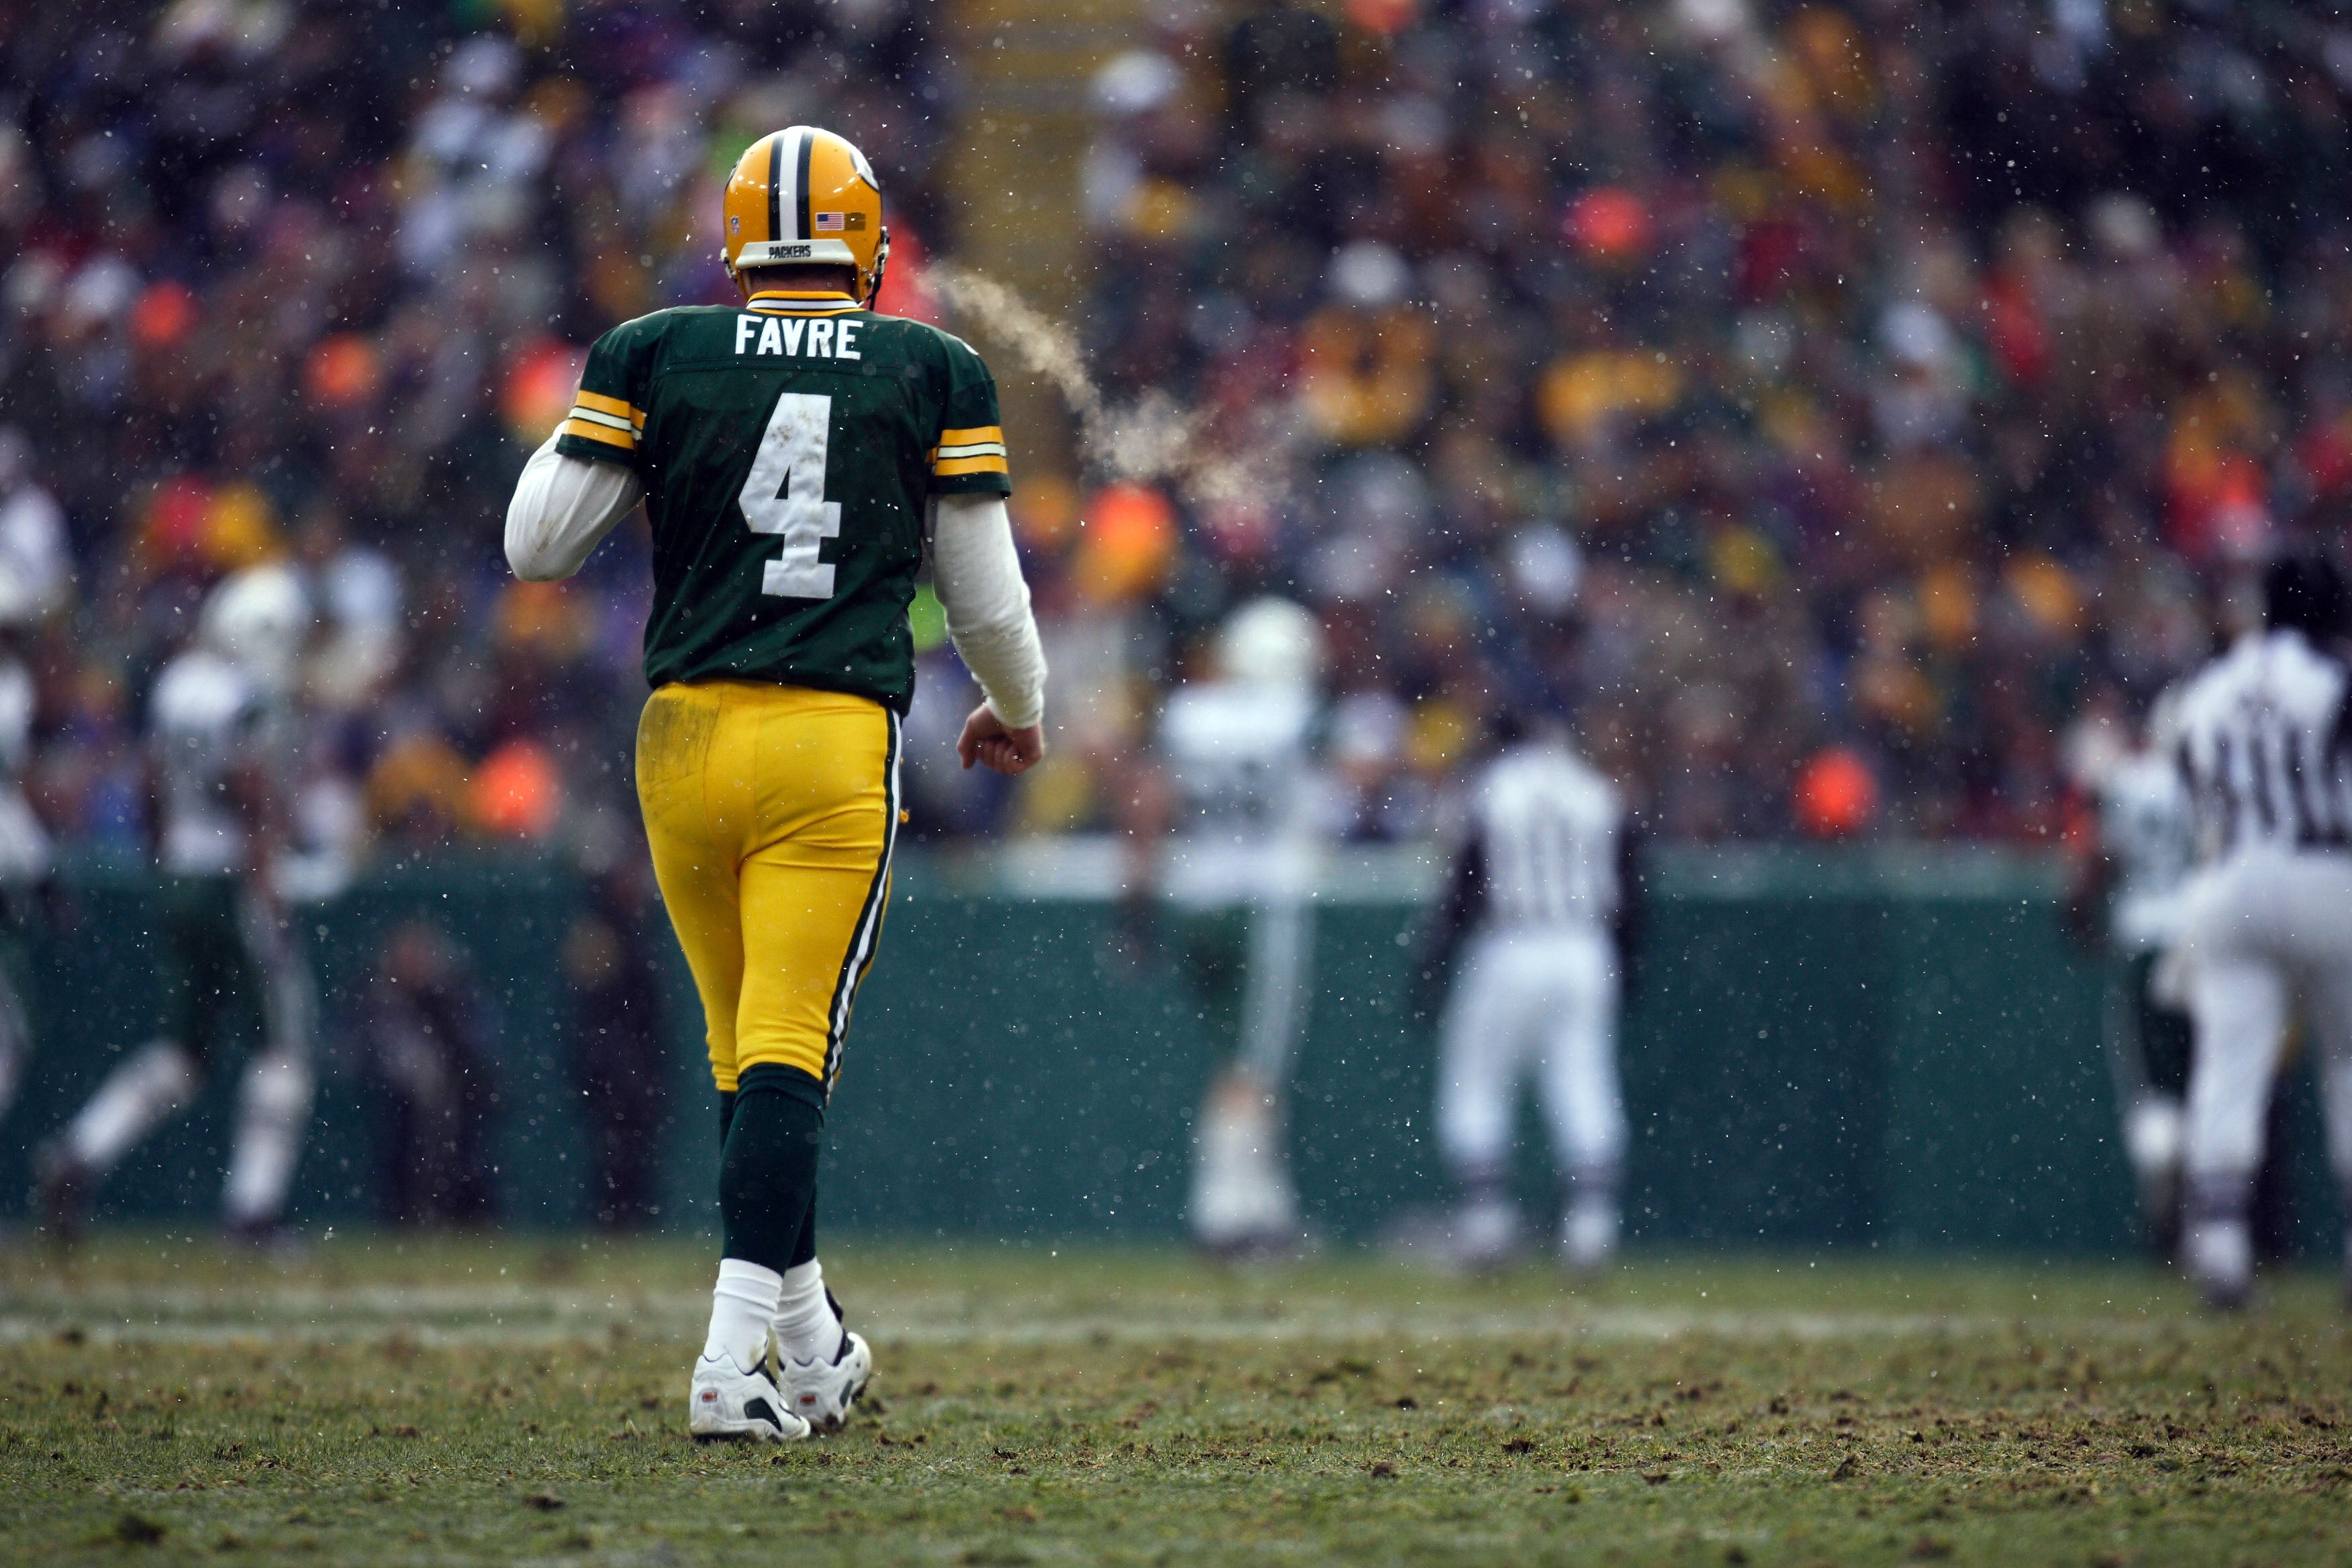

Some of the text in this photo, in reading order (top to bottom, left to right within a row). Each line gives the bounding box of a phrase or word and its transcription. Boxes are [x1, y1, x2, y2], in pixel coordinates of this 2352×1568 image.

[769, 244, 812, 259] PACKERS
[734, 313, 864, 361] FAVRE
[738, 392, 842, 599] 4
